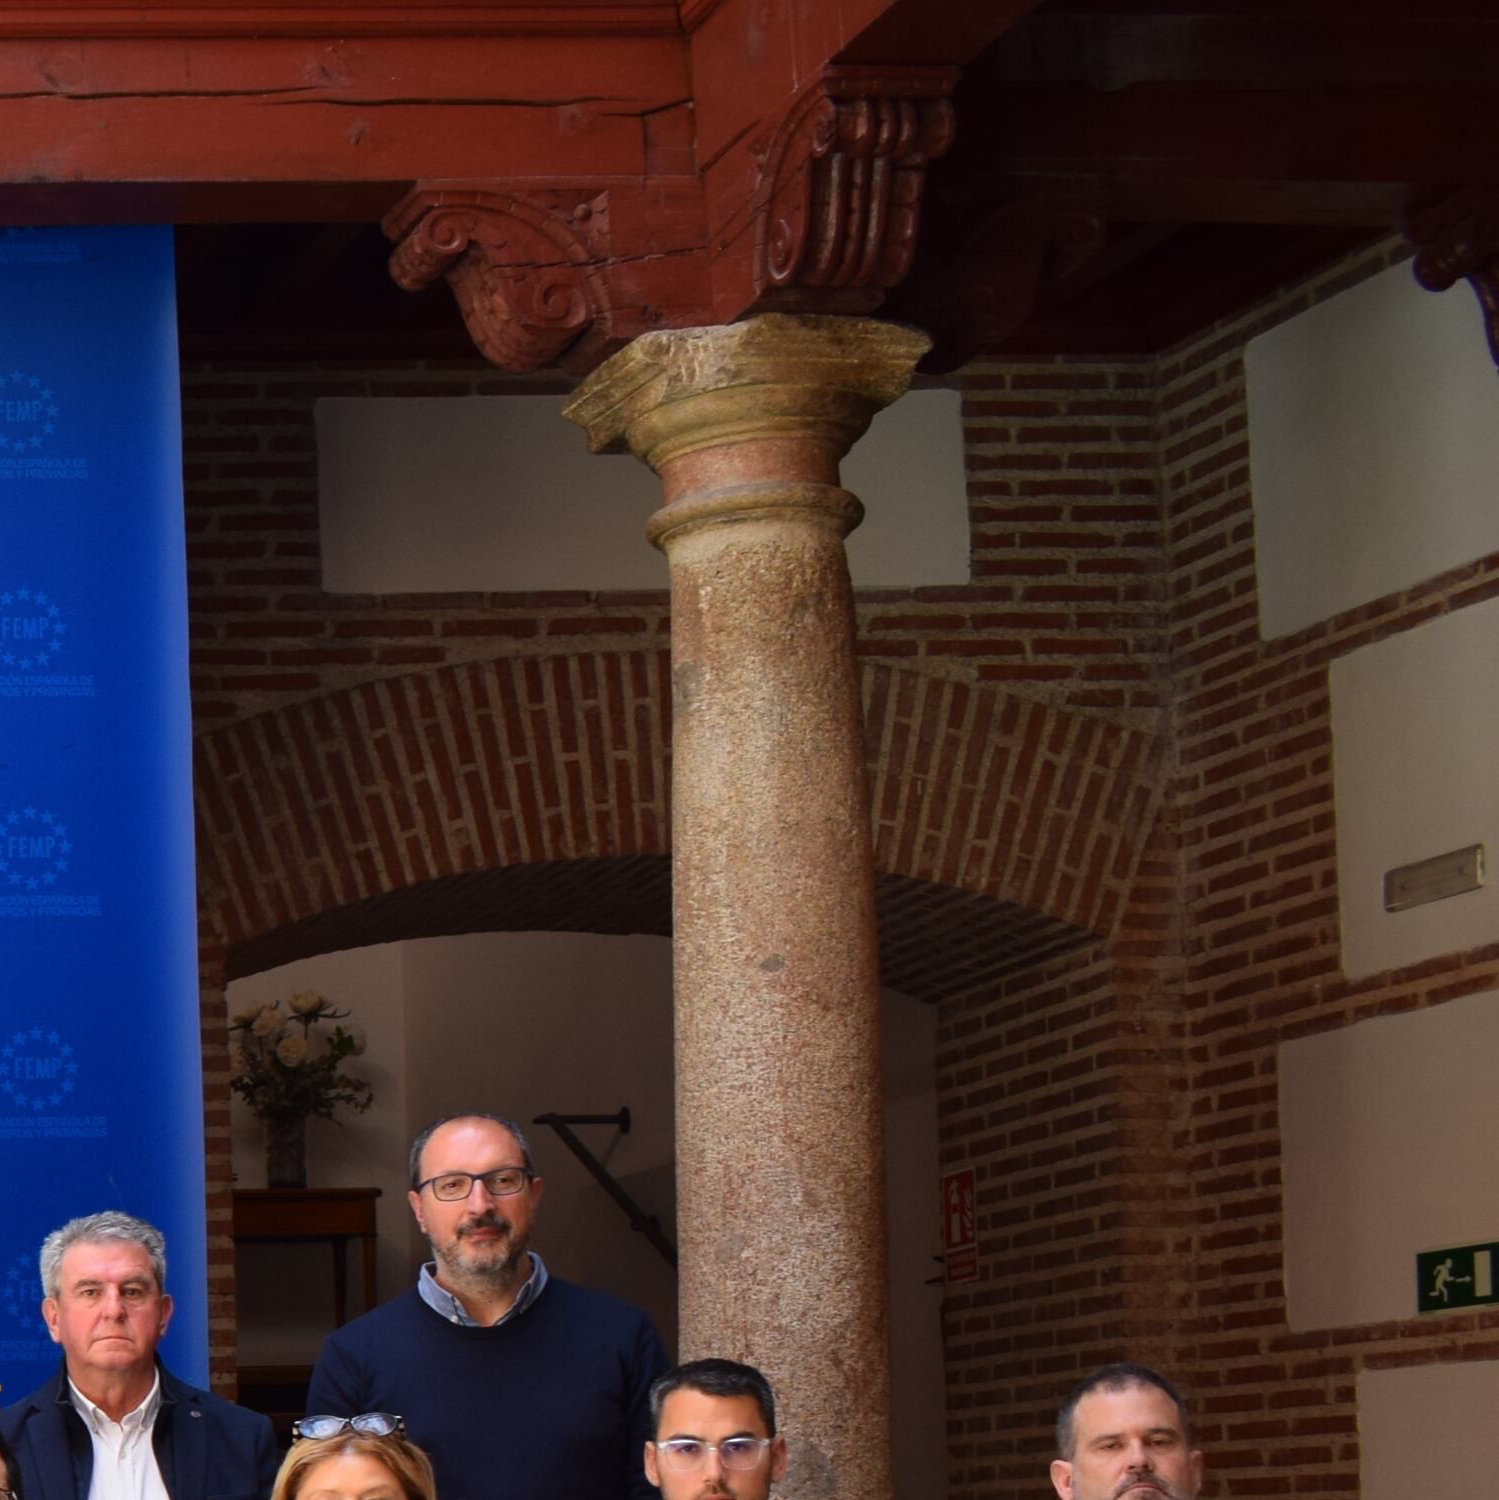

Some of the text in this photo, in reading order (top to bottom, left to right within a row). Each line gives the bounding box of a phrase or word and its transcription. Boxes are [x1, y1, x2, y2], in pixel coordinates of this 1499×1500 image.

[1, 617, 49, 639] FEMP
[8, 836, 55, 858] FEMP
[14, 1057, 61, 1079] FEMP
